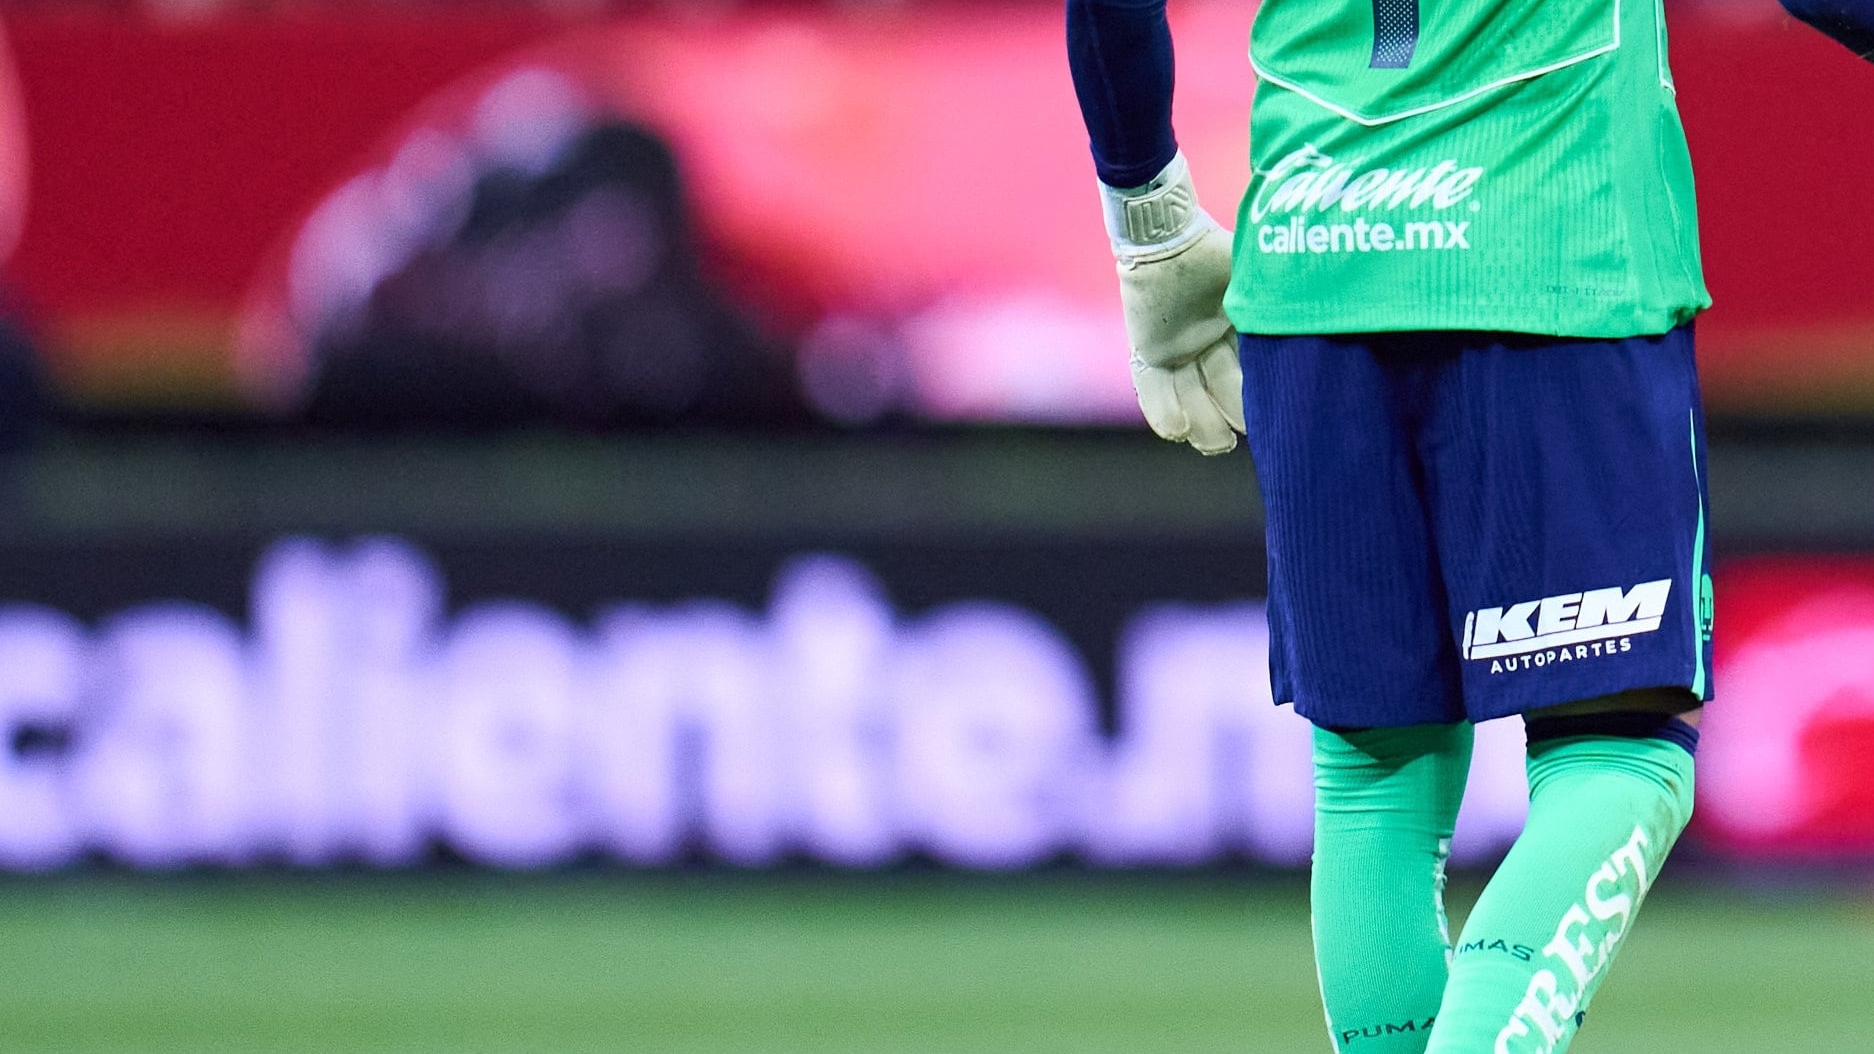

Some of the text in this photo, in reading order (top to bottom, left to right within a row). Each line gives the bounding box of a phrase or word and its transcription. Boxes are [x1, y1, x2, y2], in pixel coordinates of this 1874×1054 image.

[1251, 142, 1484, 224] Caliente
[1258, 215, 1471, 254] caliente.mx
[1490, 636, 1633, 674] AUTOPARTES
